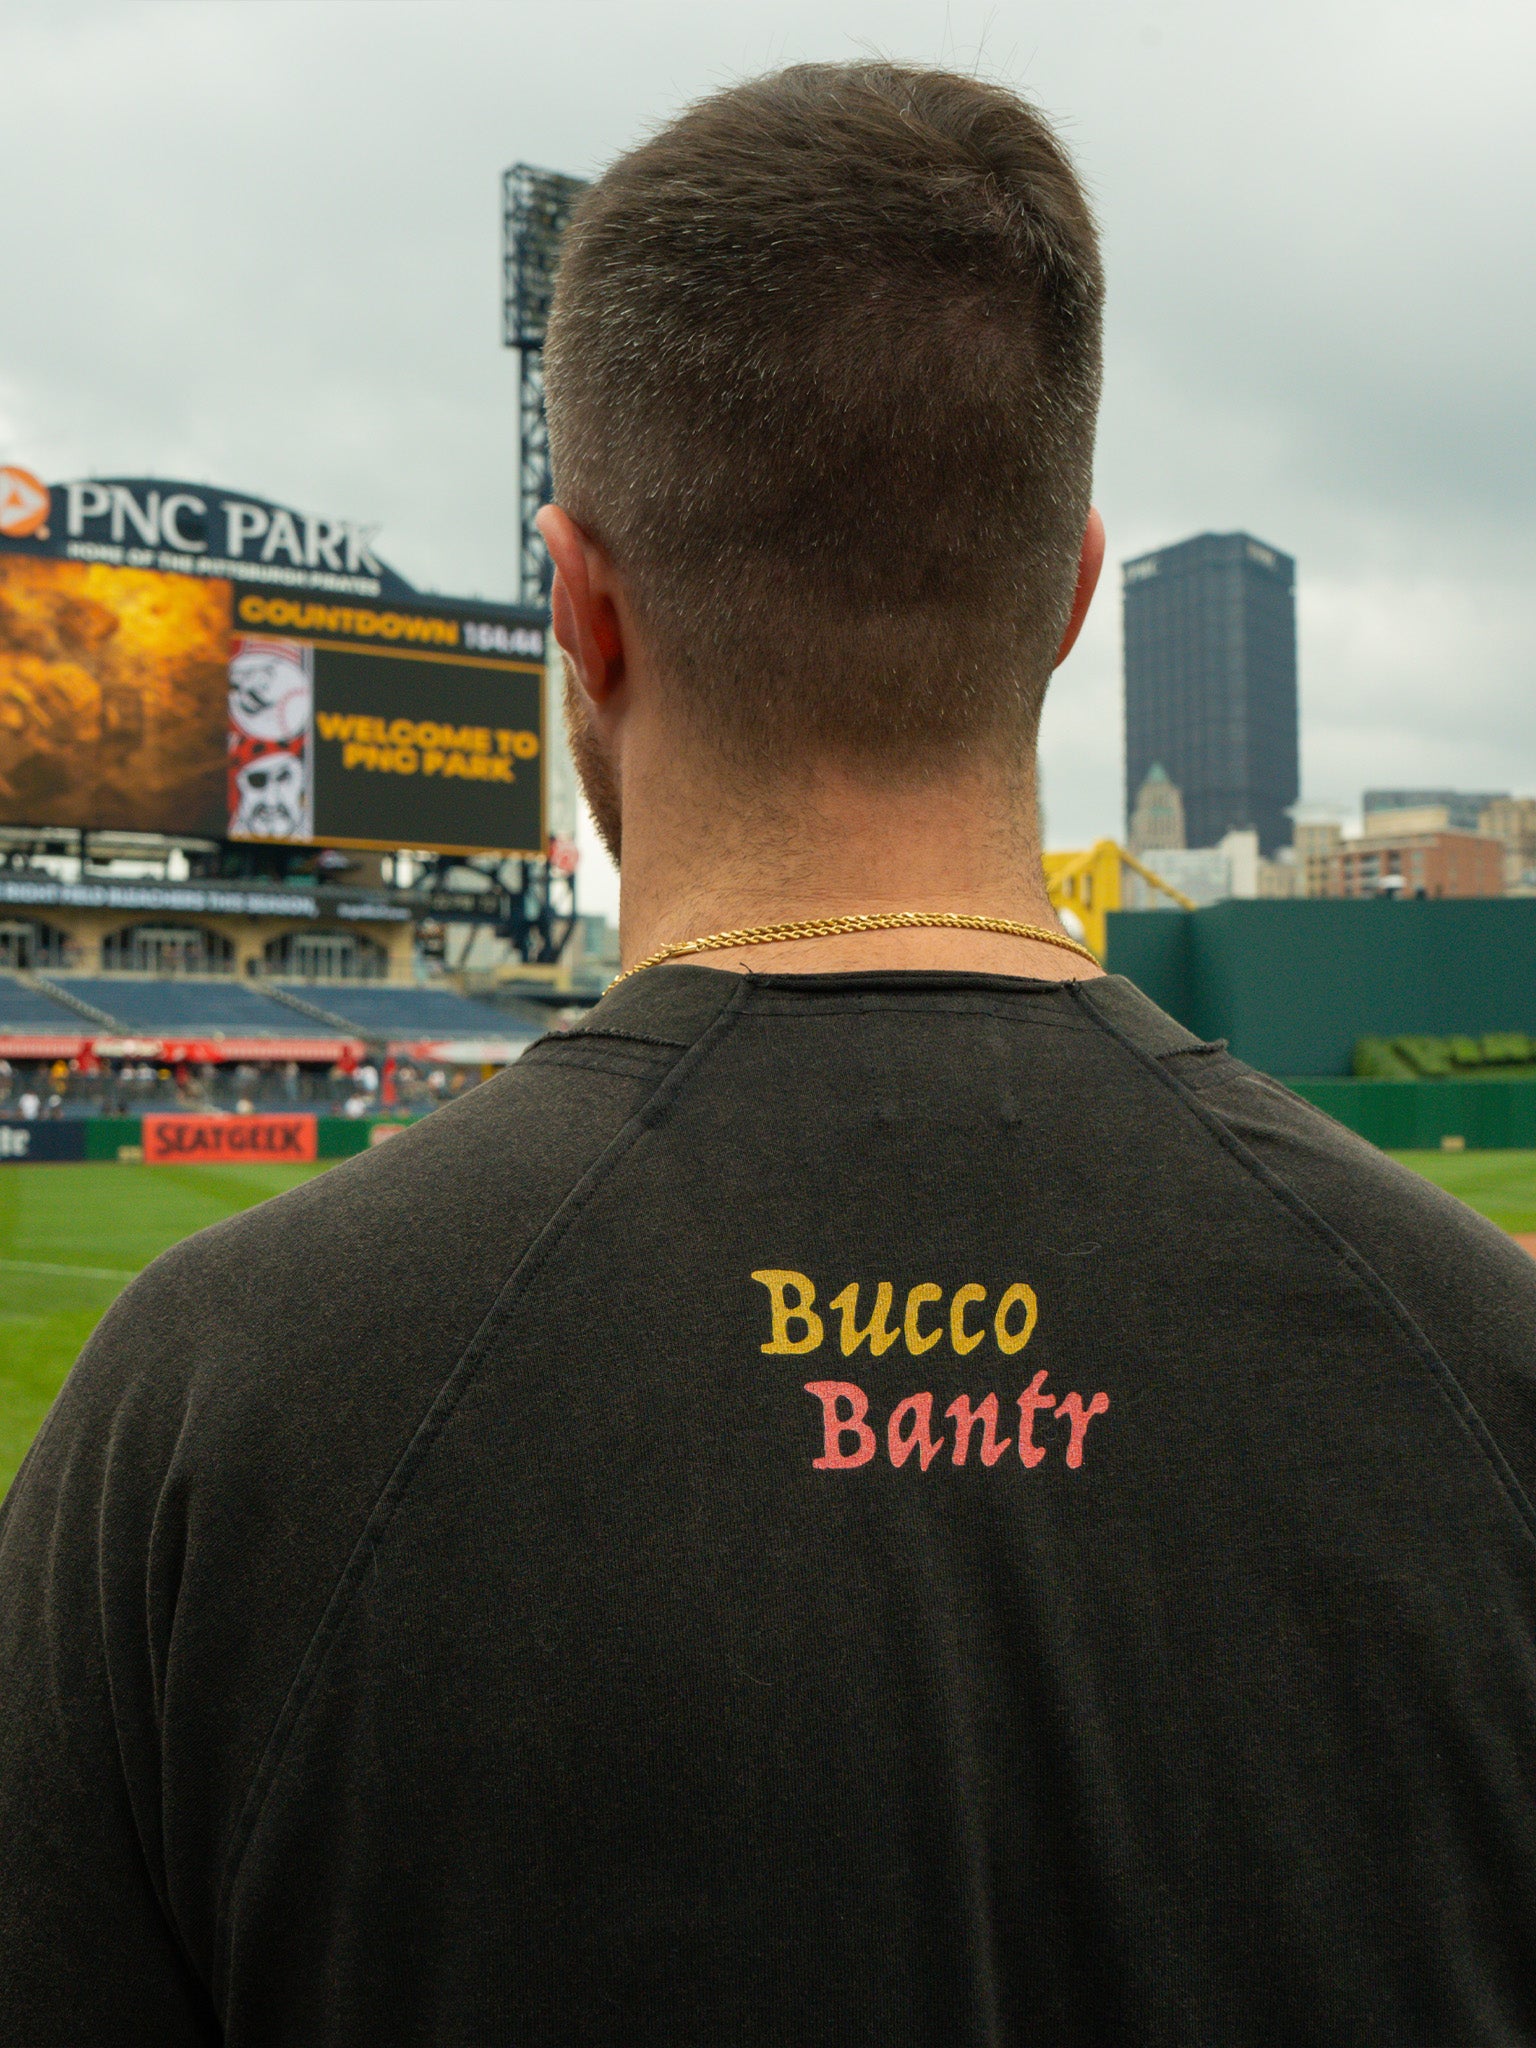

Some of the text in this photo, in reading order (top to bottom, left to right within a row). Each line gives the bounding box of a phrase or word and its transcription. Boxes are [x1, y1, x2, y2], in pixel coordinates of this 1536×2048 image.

[63, 482, 384, 577] PNC PARK
[68, 541, 381, 597] HOME OF THE PITTSBURGH PIRATES
[238, 595, 459, 646] COUNTDOWN
[316, 710, 539, 759] WELCOME TO
[343, 742, 515, 783] PNC PARK
[154, 1121, 304, 1156] SEATGEEK
[750, 1269, 1038, 1357] Bucco
[804, 1370, 1109, 1471] Bantr
